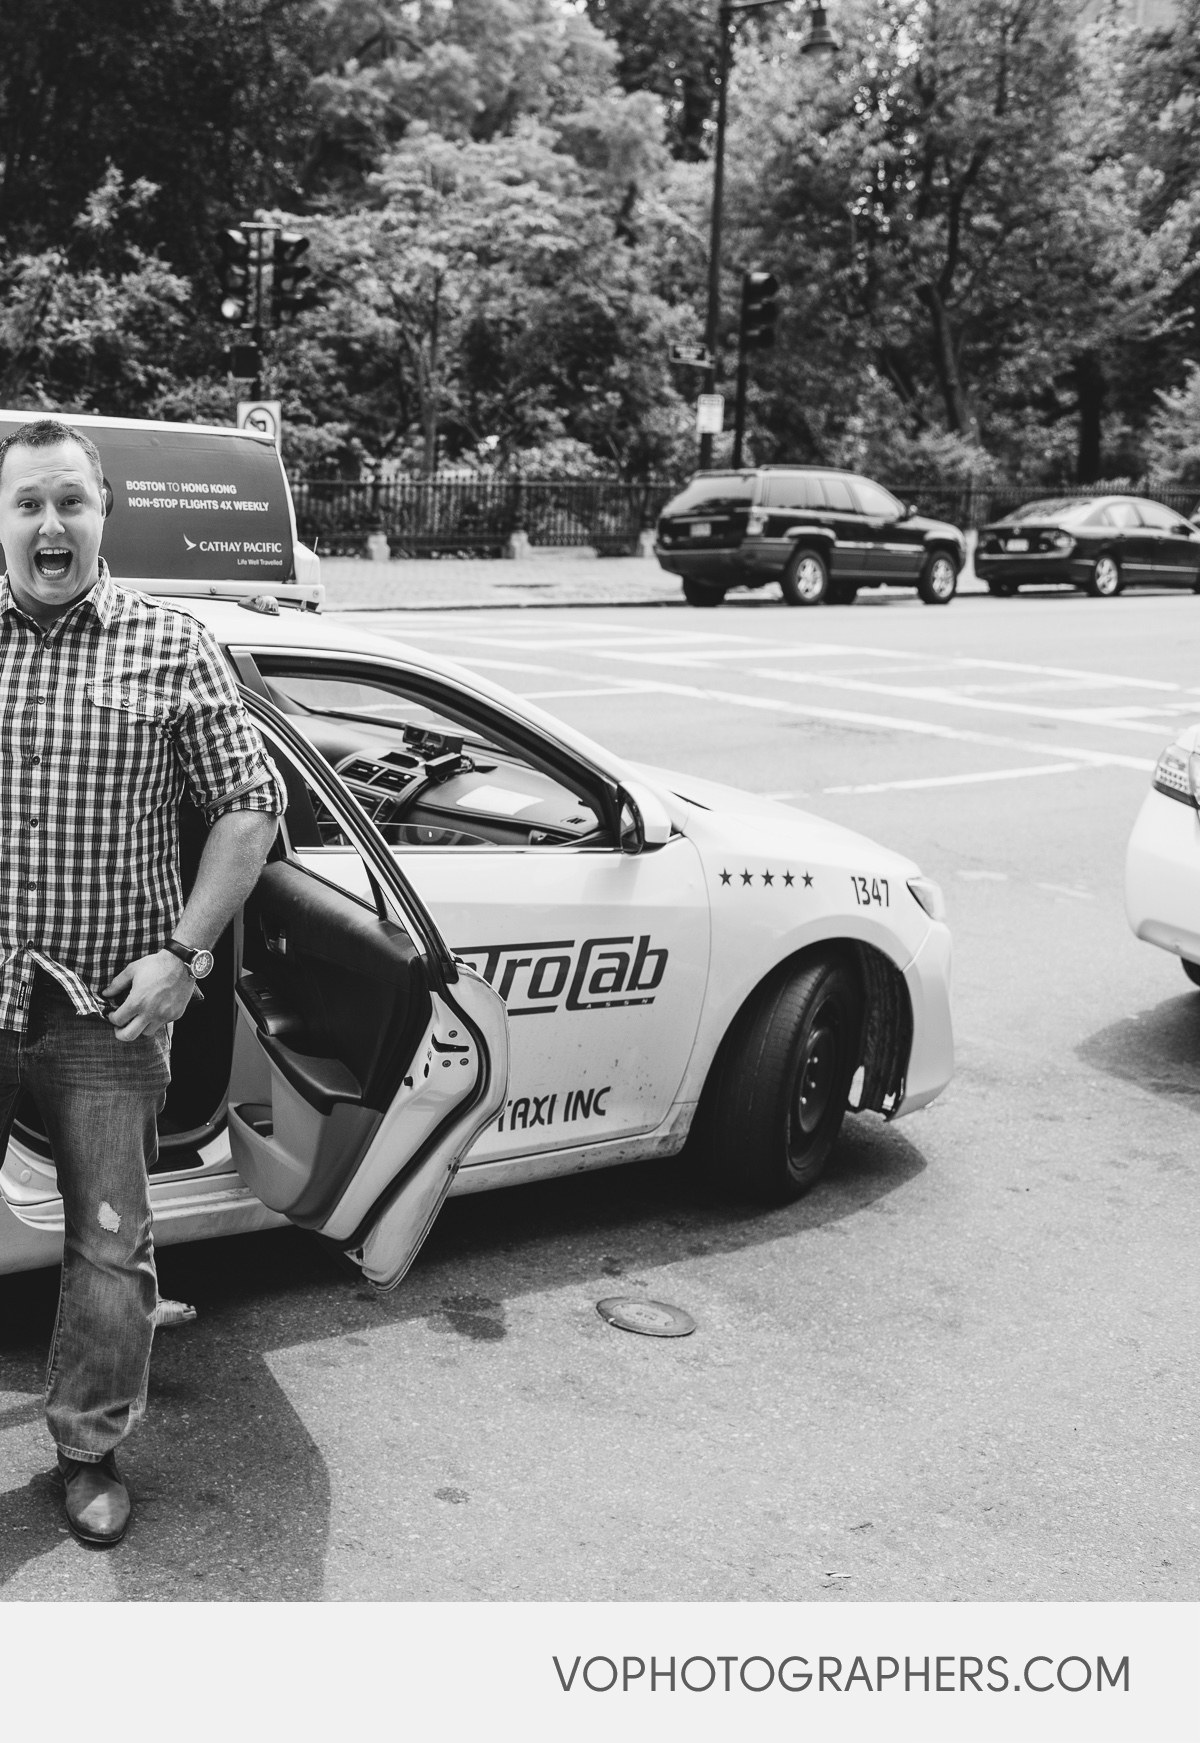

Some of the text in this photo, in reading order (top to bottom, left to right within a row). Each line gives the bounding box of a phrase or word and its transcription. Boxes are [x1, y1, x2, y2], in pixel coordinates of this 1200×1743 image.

[125, 480, 238, 495] BOSTON TO HONG KONG
[128, 497, 270, 512] NON-STOP FLIGHTS 4X WEEKLY
[199, 540, 283, 553] CATHAY PACIFIC
[236, 558, 284, 567] Life Well Travelled
[850, 876, 890, 907] 1347
[564, 1086, 612, 1123] INC
